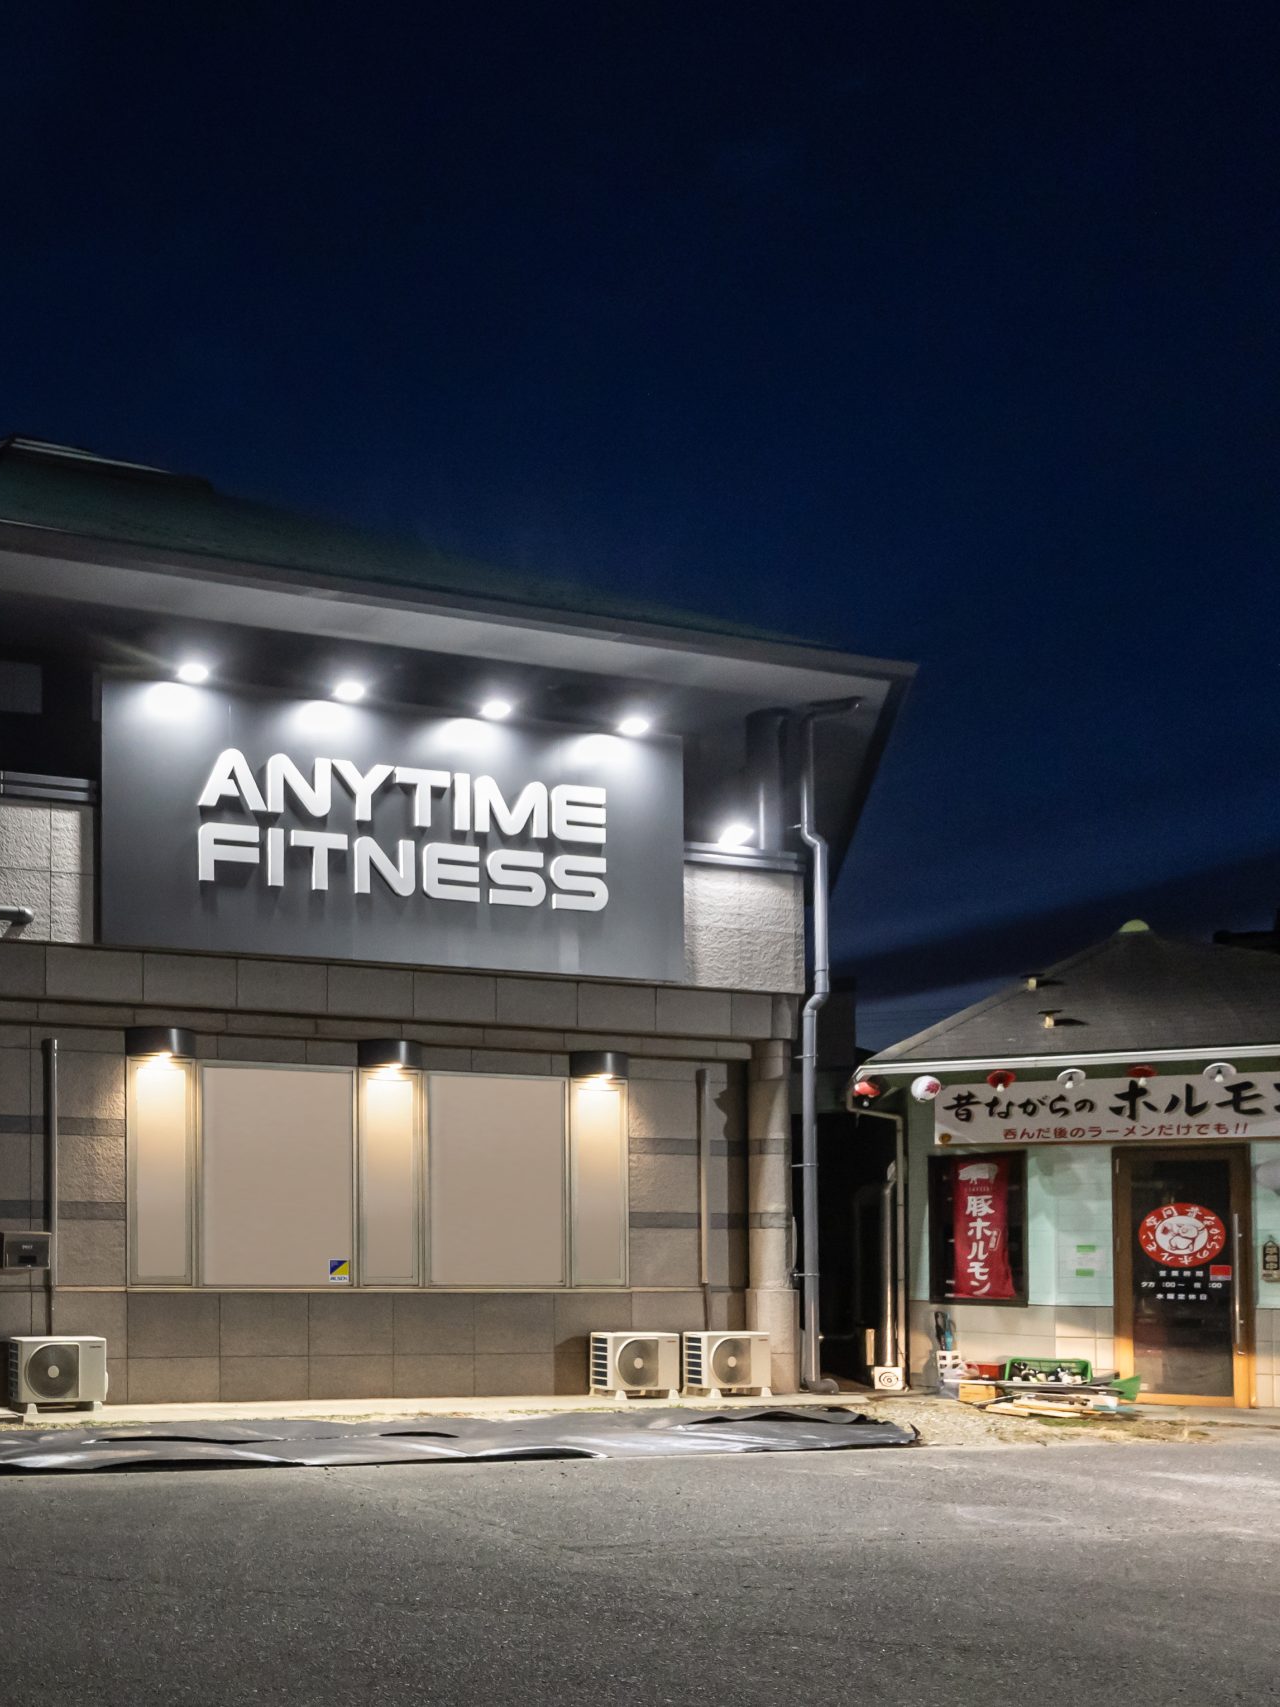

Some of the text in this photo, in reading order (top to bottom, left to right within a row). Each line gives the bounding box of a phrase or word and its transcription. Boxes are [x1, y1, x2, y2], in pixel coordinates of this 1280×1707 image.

[197, 748, 607, 844] ANYTIME
[198, 822, 609, 912] FITNESS
[942, 1091, 1096, 1123] 昔ながらの
[965, 1195, 996, 1296] 豚ホルモン
